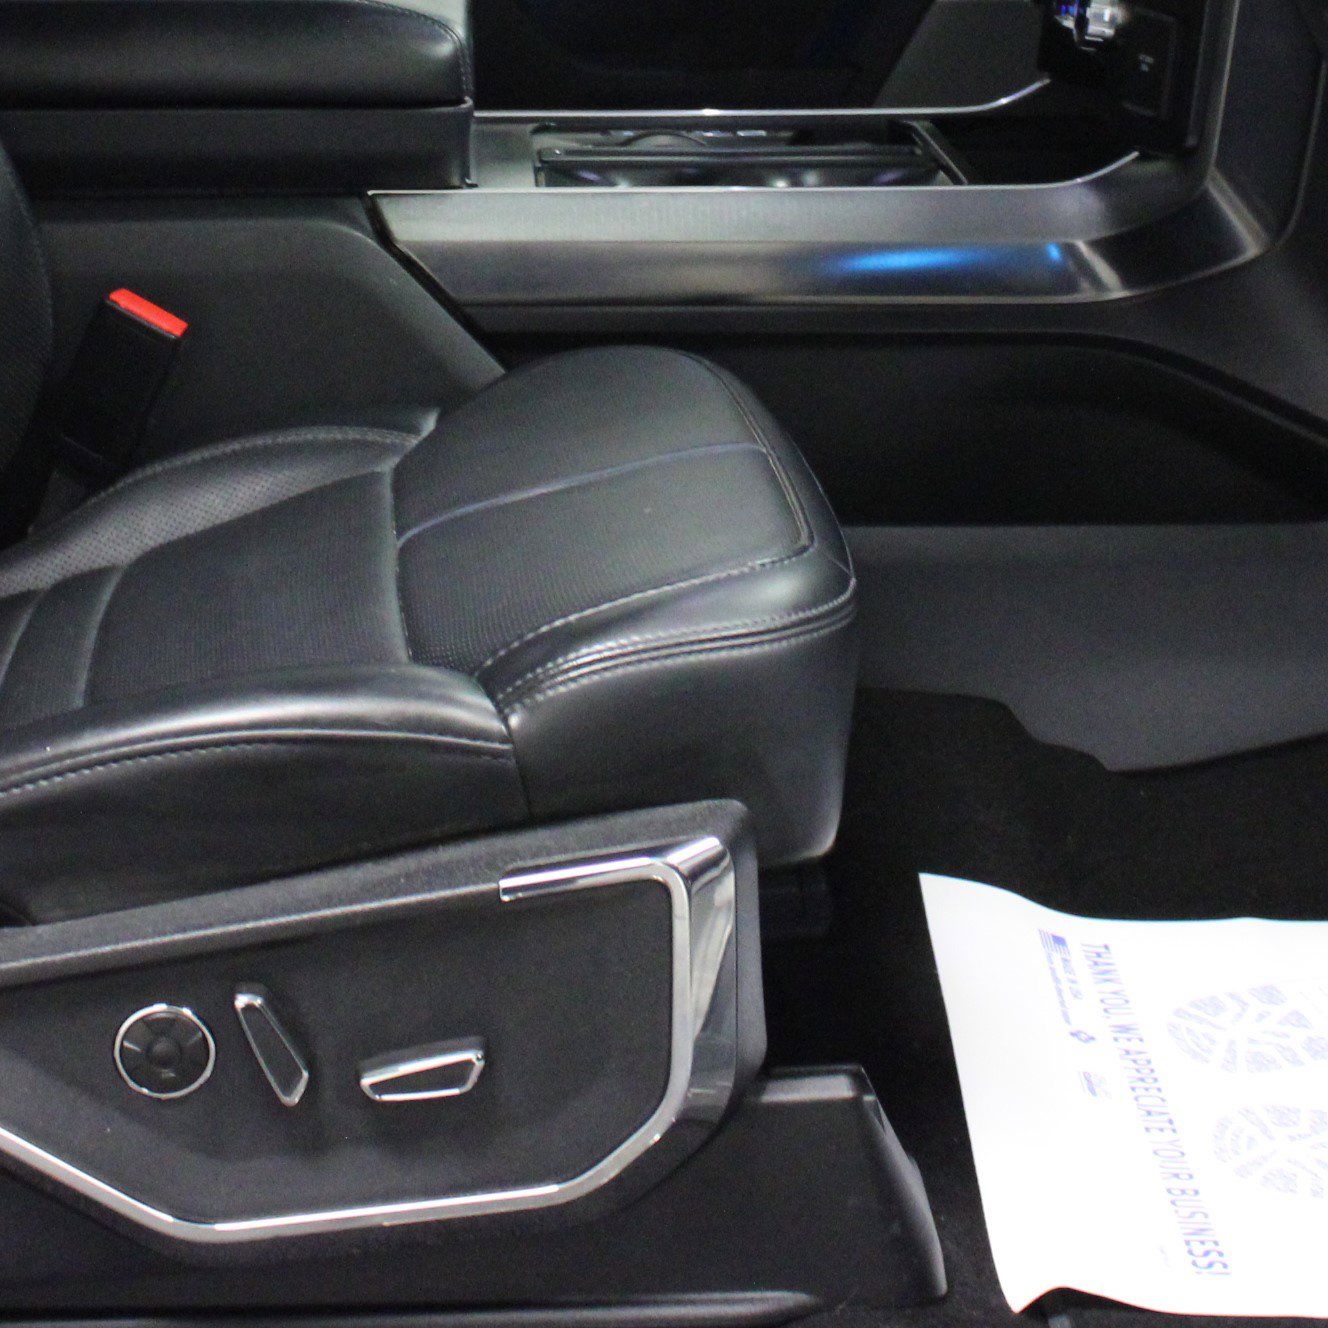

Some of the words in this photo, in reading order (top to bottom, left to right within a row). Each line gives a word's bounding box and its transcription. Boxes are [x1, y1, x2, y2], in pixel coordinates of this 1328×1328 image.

[1080, 943, 1124, 985] THANK
[1108, 1022, 1145, 1043] WE
[1116, 1047, 1178, 1134] APPRECIATE
[1148, 1139, 1194, 1181] YOUR
[1165, 1187, 1232, 1276] BUSINESS!
